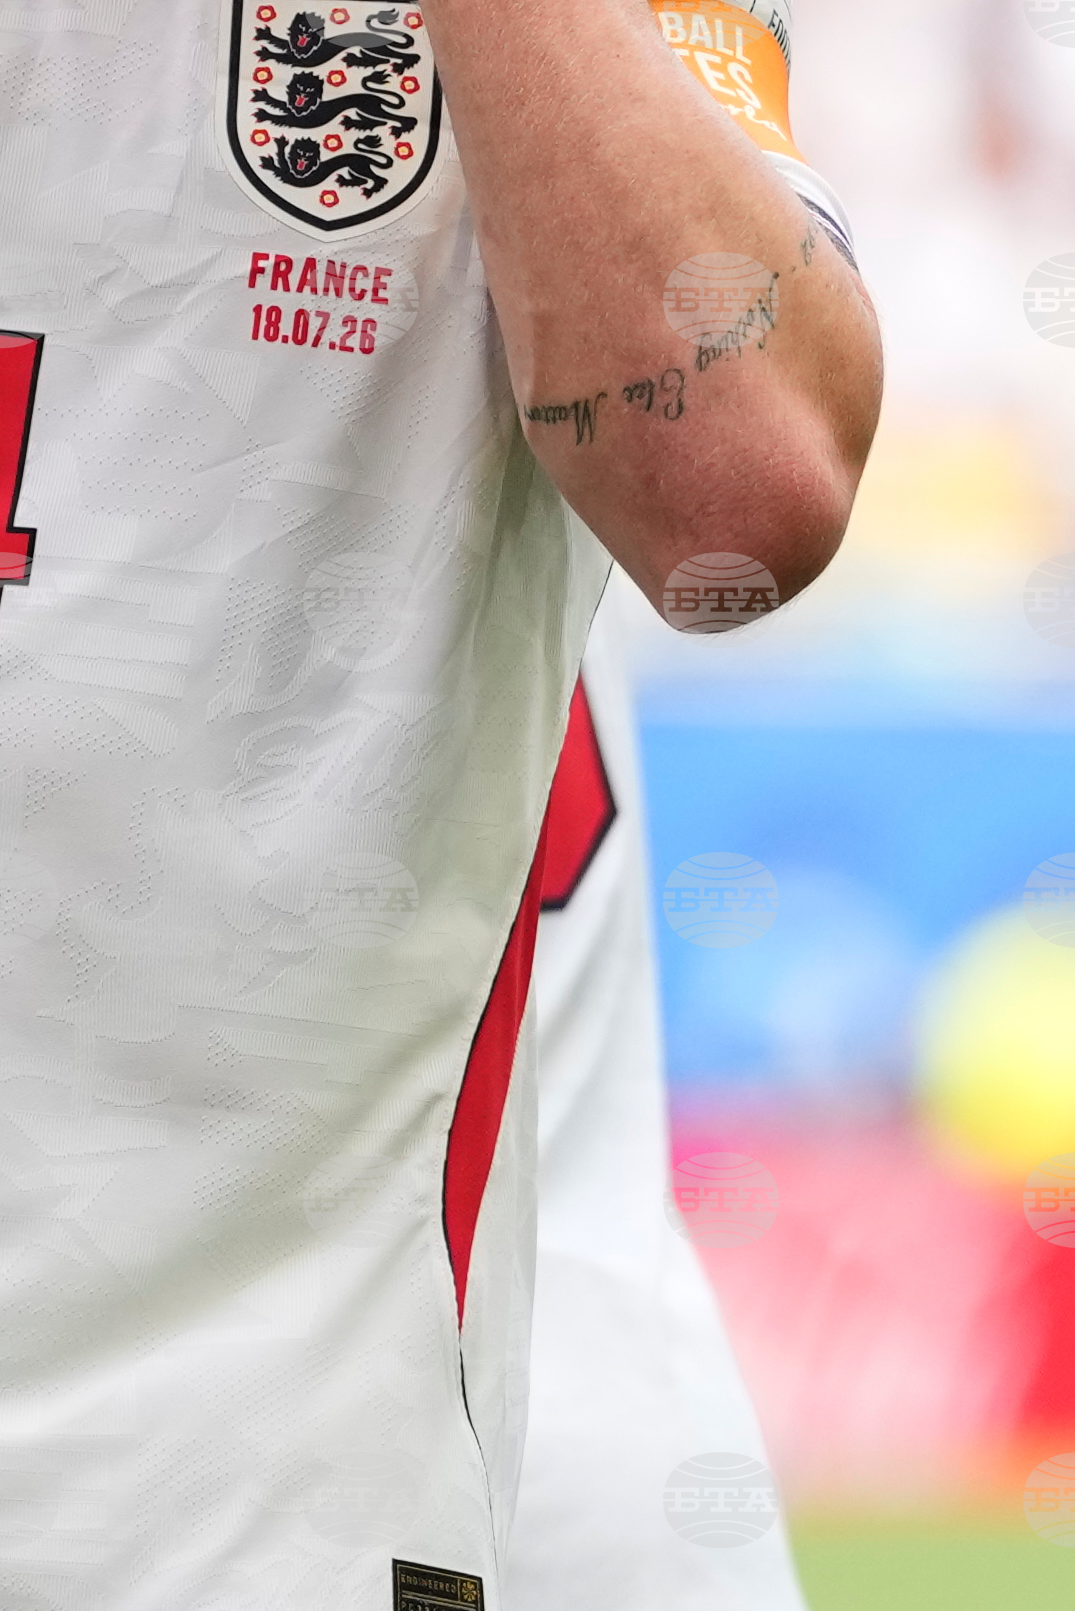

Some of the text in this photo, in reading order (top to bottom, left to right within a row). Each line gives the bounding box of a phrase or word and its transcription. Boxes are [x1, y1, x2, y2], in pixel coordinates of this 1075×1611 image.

[658, 10, 752, 66] BALL
[248, 251, 394, 305] FRANCE
[251, 304, 378, 355] 18.07.26
